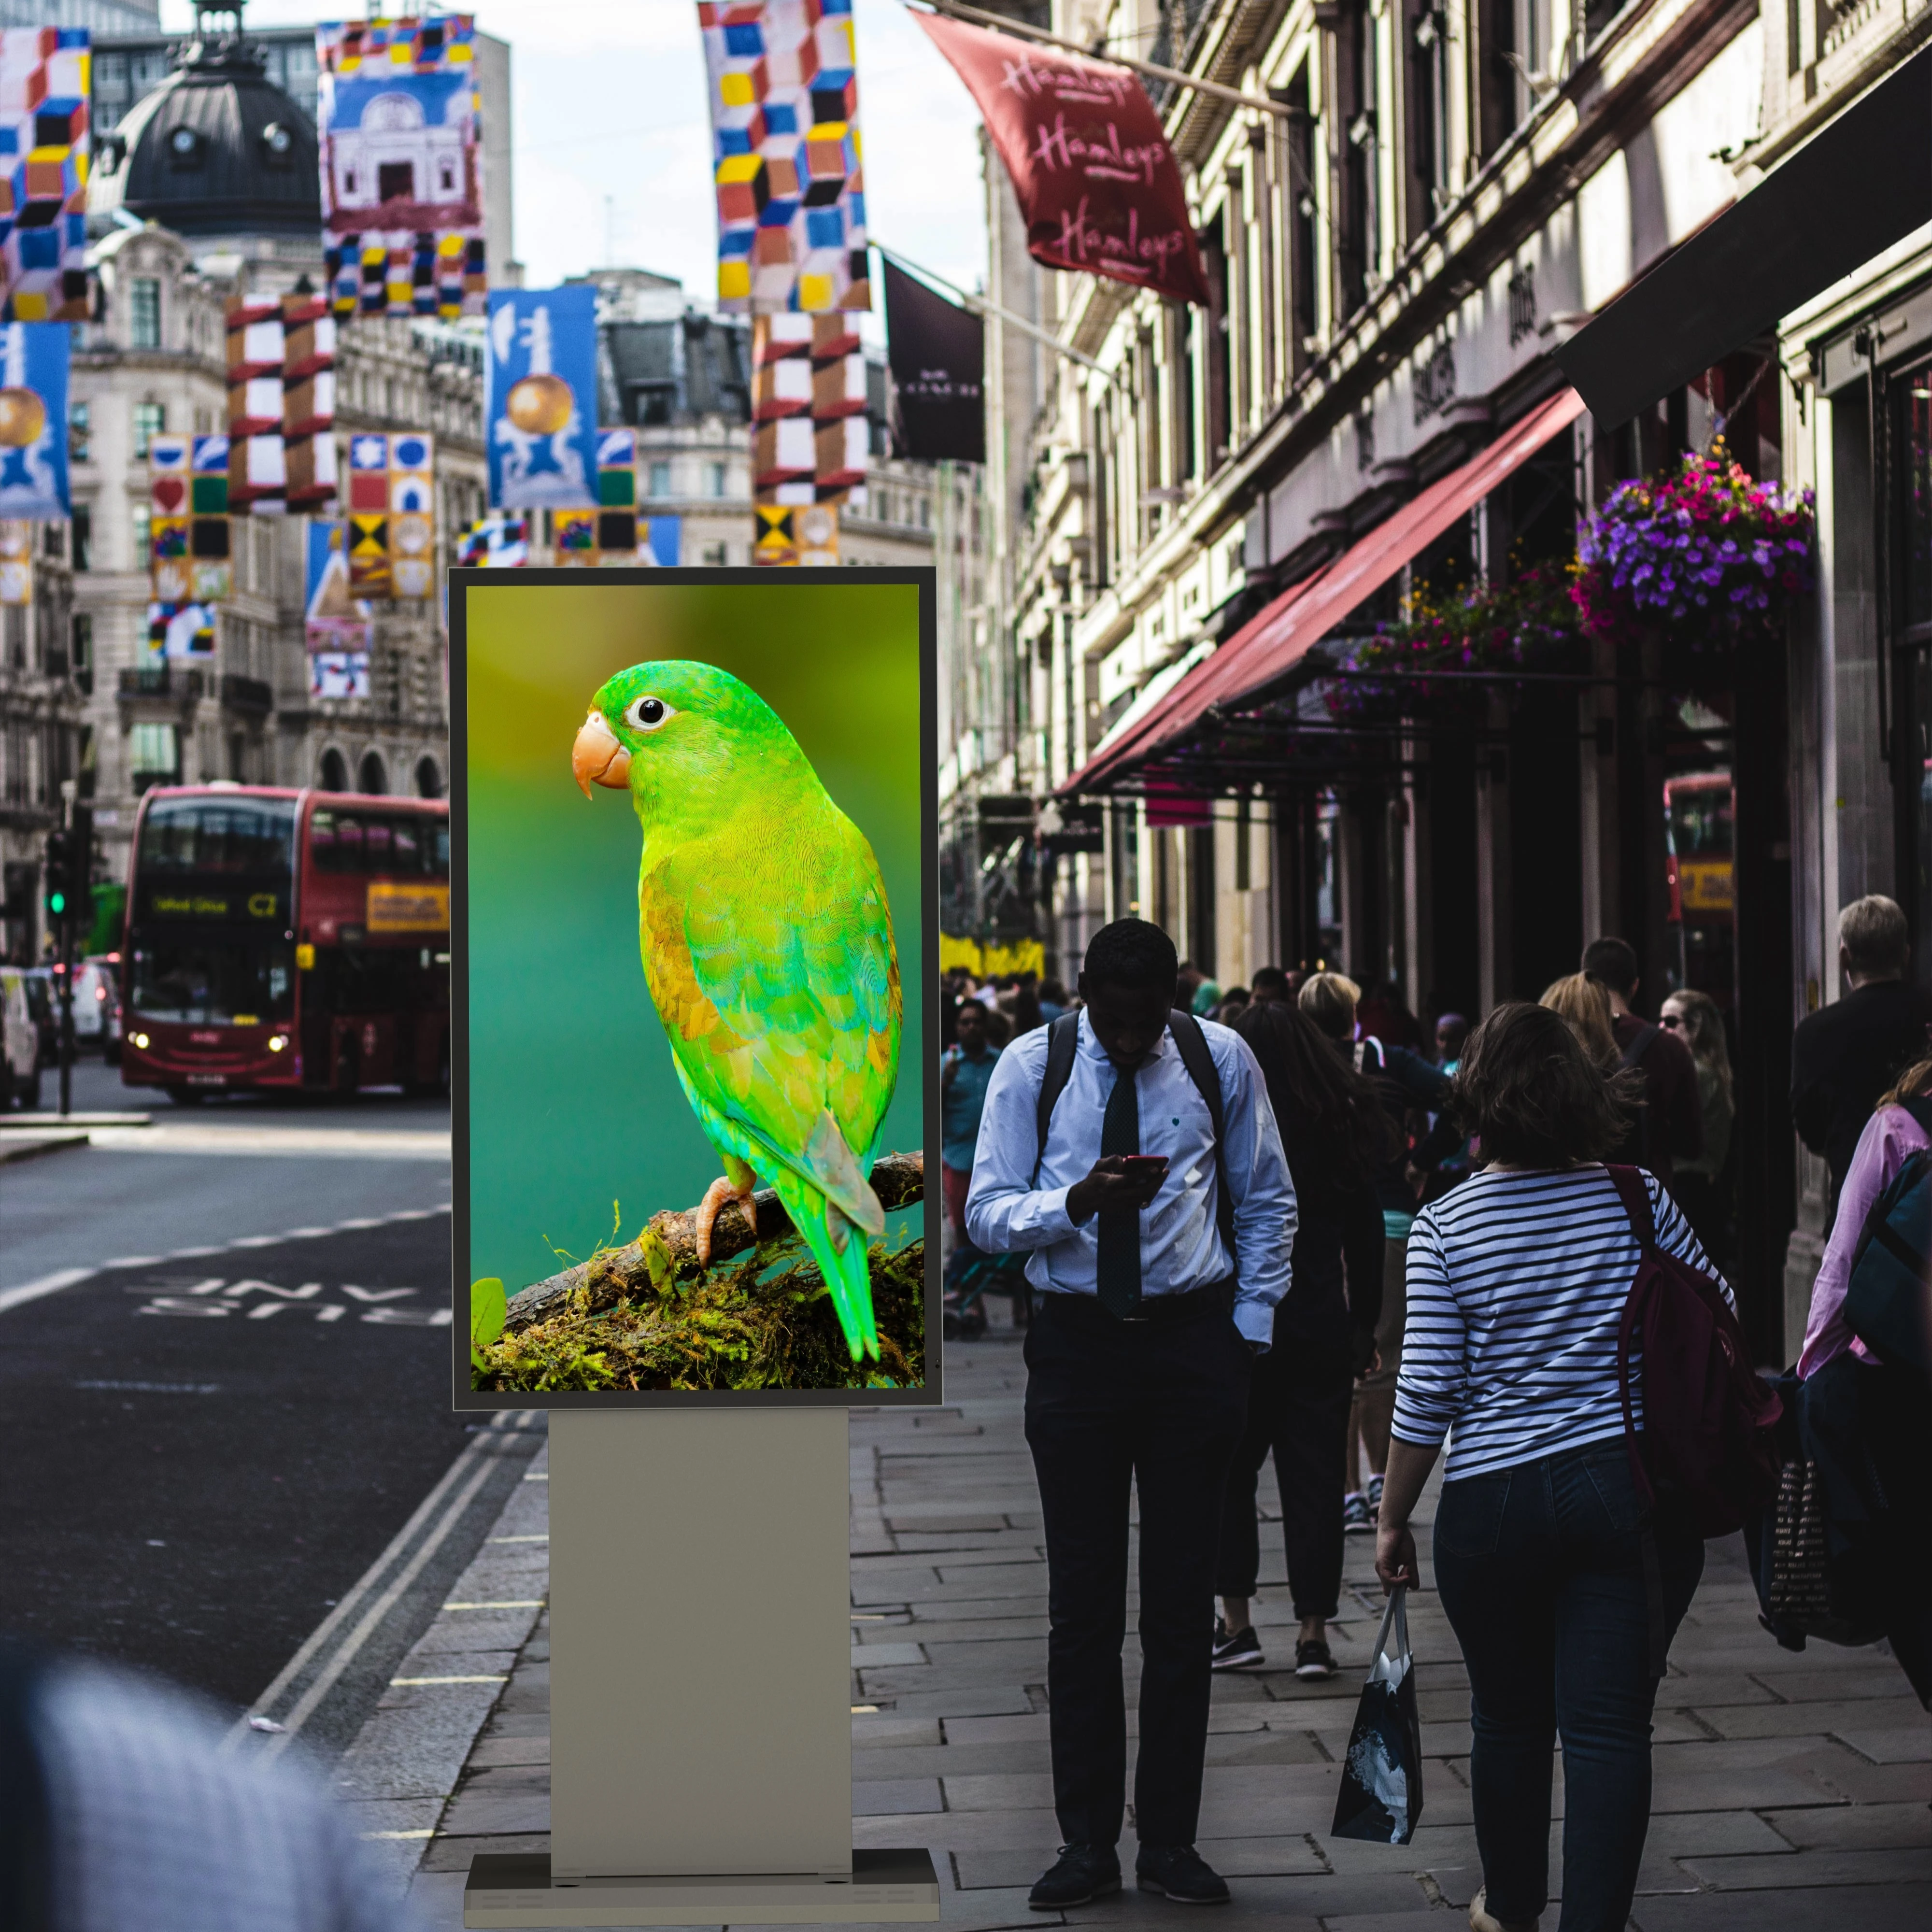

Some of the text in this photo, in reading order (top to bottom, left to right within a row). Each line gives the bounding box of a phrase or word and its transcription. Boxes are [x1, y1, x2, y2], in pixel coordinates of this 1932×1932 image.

[1001, 52, 1135, 108] Hamleys
[1031, 110, 1165, 187] Hamleys
[1051, 195, 1185, 282] Hamleys
